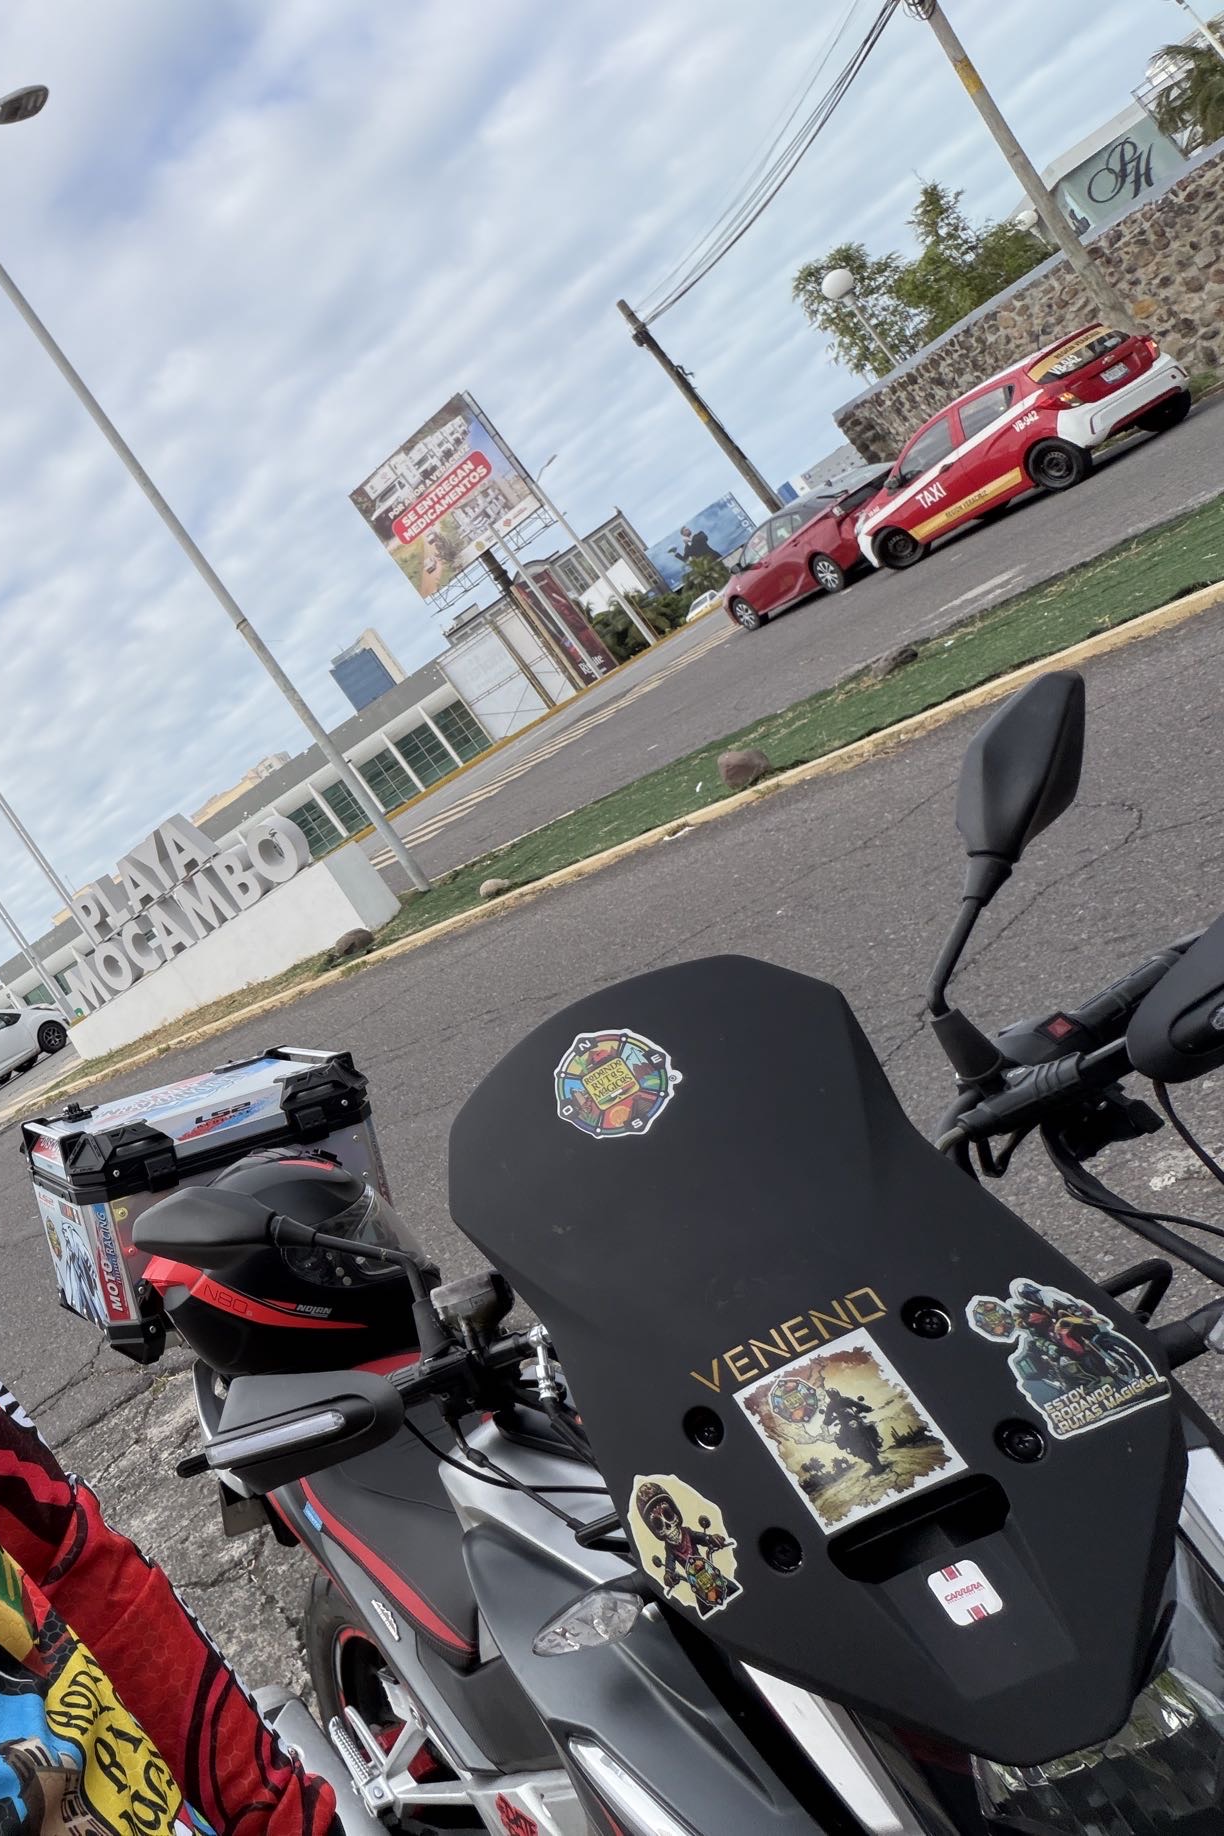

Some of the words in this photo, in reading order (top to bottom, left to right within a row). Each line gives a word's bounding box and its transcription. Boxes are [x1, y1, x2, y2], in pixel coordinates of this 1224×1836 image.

[1012, 410, 1040, 432] VB-942
[388, 503, 405, 520] POR
[430, 444, 472, 481] VERACRUZ
[401, 510, 418, 528] SE
[415, 460, 475, 515] ENTREGAN
[915, 481, 947, 509] TAXI
[402, 464, 488, 541] MEDICAMENTOS
[77, 813, 222, 944] PLAYA
[64, 816, 310, 1017] MOCAMBO
[578, 1040, 592, 1051] N
[650, 1053, 662, 1064] E
[195, 1101, 251, 1124] LS2
[631, 1118, 644, 1129] S
[99, 1210, 118, 1256] RACING
[100, 1261, 124, 1312] MOTO
[296, 1304, 333, 1318] NOLAN
[689, 1286, 888, 1393] VENENO
[1043, 1385, 1087, 1414] ESTOY
[1057, 1403, 1103, 1434] RUTAS
[1103, 1374, 1157, 1410] MAGICAS
[944, 1581, 984, 1602] CARRERA
